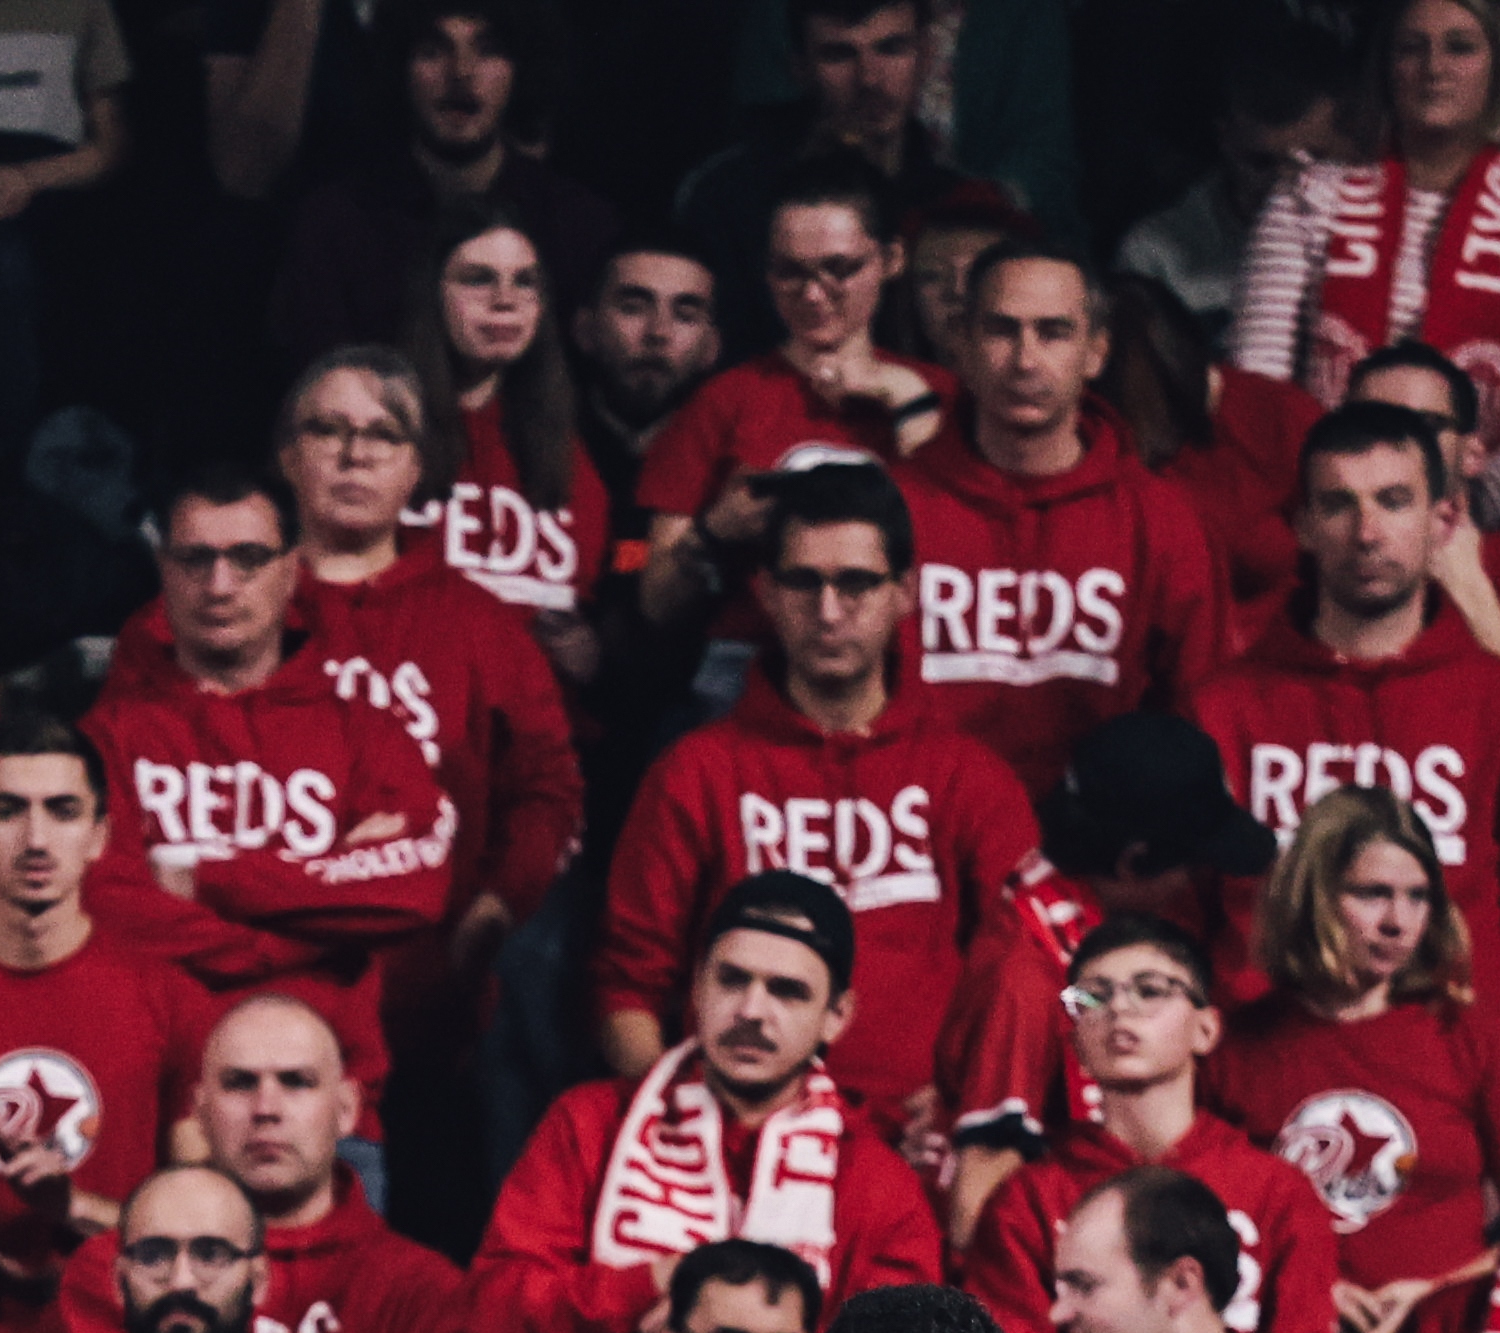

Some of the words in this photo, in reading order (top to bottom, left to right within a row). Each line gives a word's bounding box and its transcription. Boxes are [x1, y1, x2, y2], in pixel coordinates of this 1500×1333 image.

[400, 484, 577, 581] EDS
[920, 562, 1126, 656] REDS
[134, 757, 337, 857] REDS
